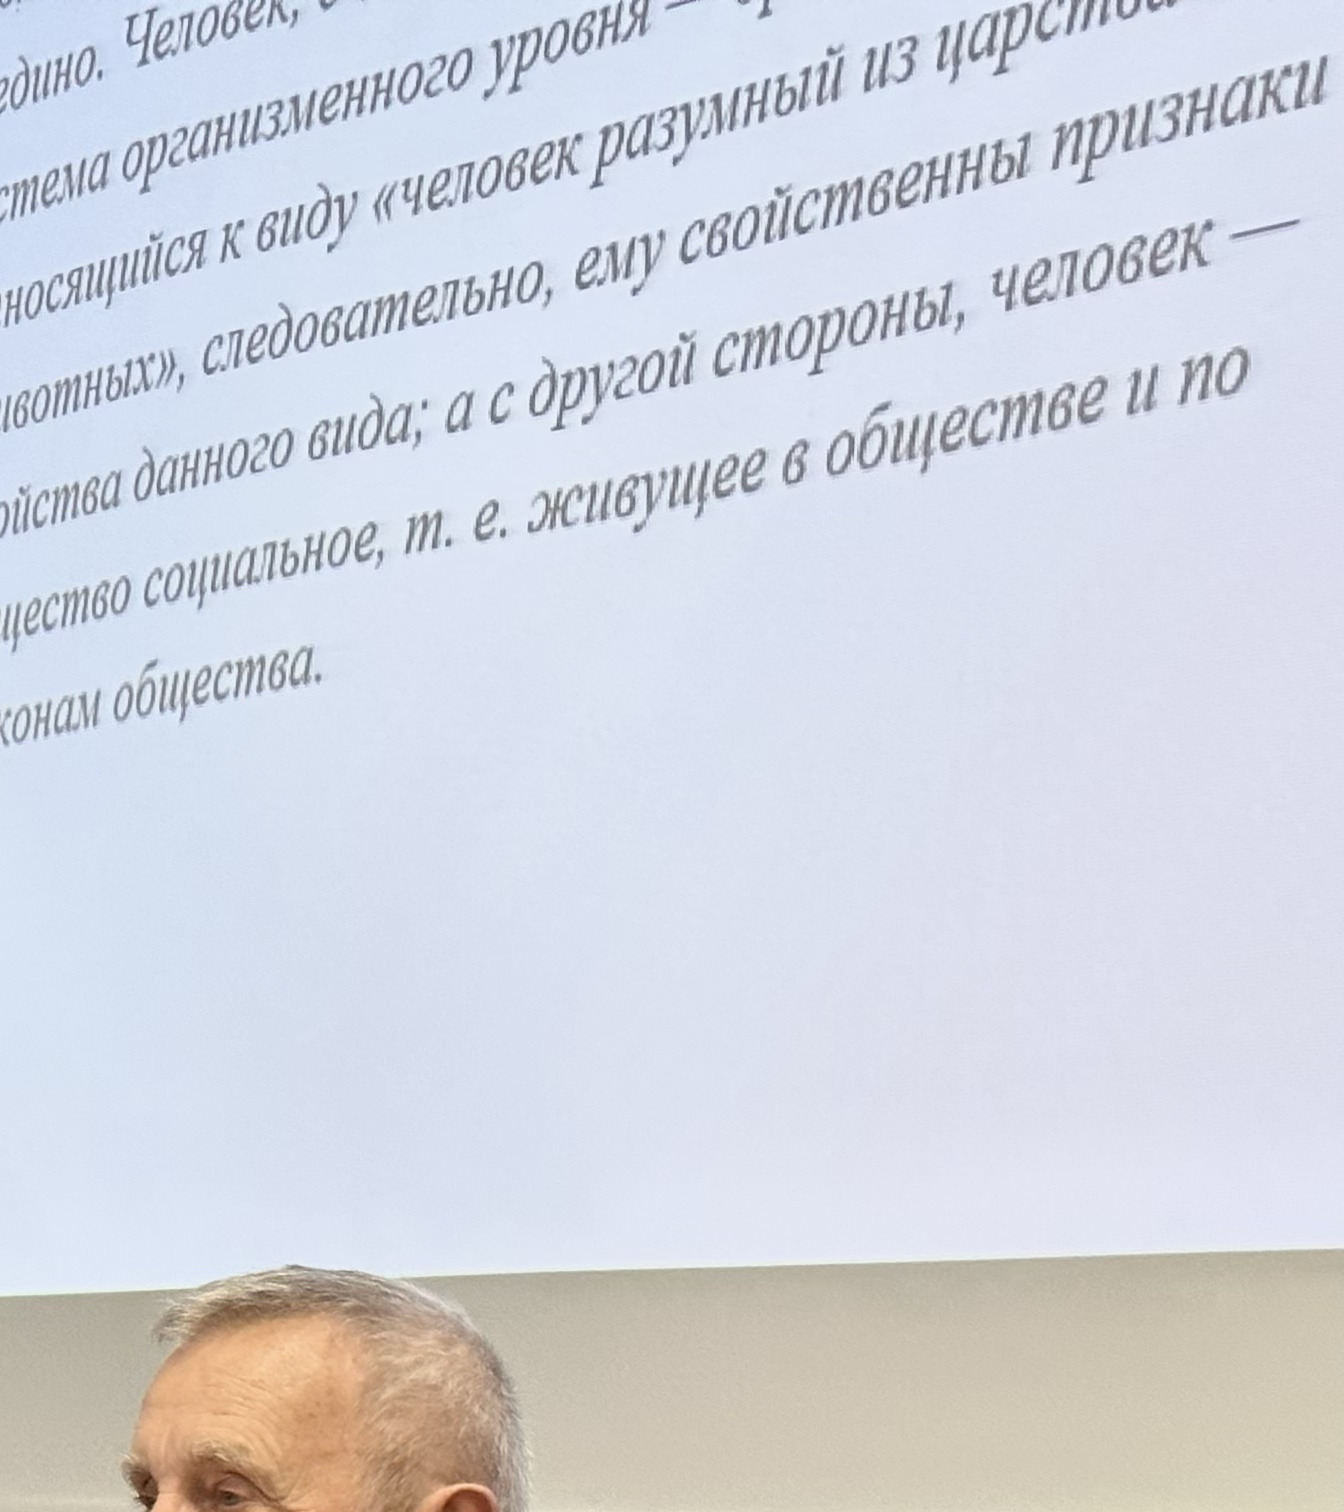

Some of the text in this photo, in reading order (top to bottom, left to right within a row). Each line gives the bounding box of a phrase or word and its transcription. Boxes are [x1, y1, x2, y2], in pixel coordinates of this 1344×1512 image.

[120, 45, 475, 197] организменного
[481, 0, 653, 103] уровня
[201, 259, 555, 377] следовательно,
[573, 227, 668, 298] ему
[677, 130, 1033, 267] свойственны
[1050, 53, 1330, 186] признаки
[218, 217, 247, 265] к
[255, 181, 360, 255] виду
[371, 131, 585, 225] «человек
[587, 42, 846, 191] разумный
[862, 33, 921, 95] из
[132, 426, 296, 504] данного
[306, 391, 430, 462] вида;
[443, 389, 476, 435] а
[487, 380, 516, 427] с
[527, 329, 698, 433] другой
[711, 279, 966, 379] стороны,
[990, 217, 1217, 313] человек
[142, 519, 386, 612] социальное,
[403, 508, 454, 557] т.
[472, 497, 508, 543] е.
[526, 446, 770, 535] живущее
[781, 437, 812, 487] в
[825, 374, 1110, 478] обществе
[1125, 362, 1161, 418] и
[1176, 344, 1253, 407] по
[111, 644, 323, 725] общества.
